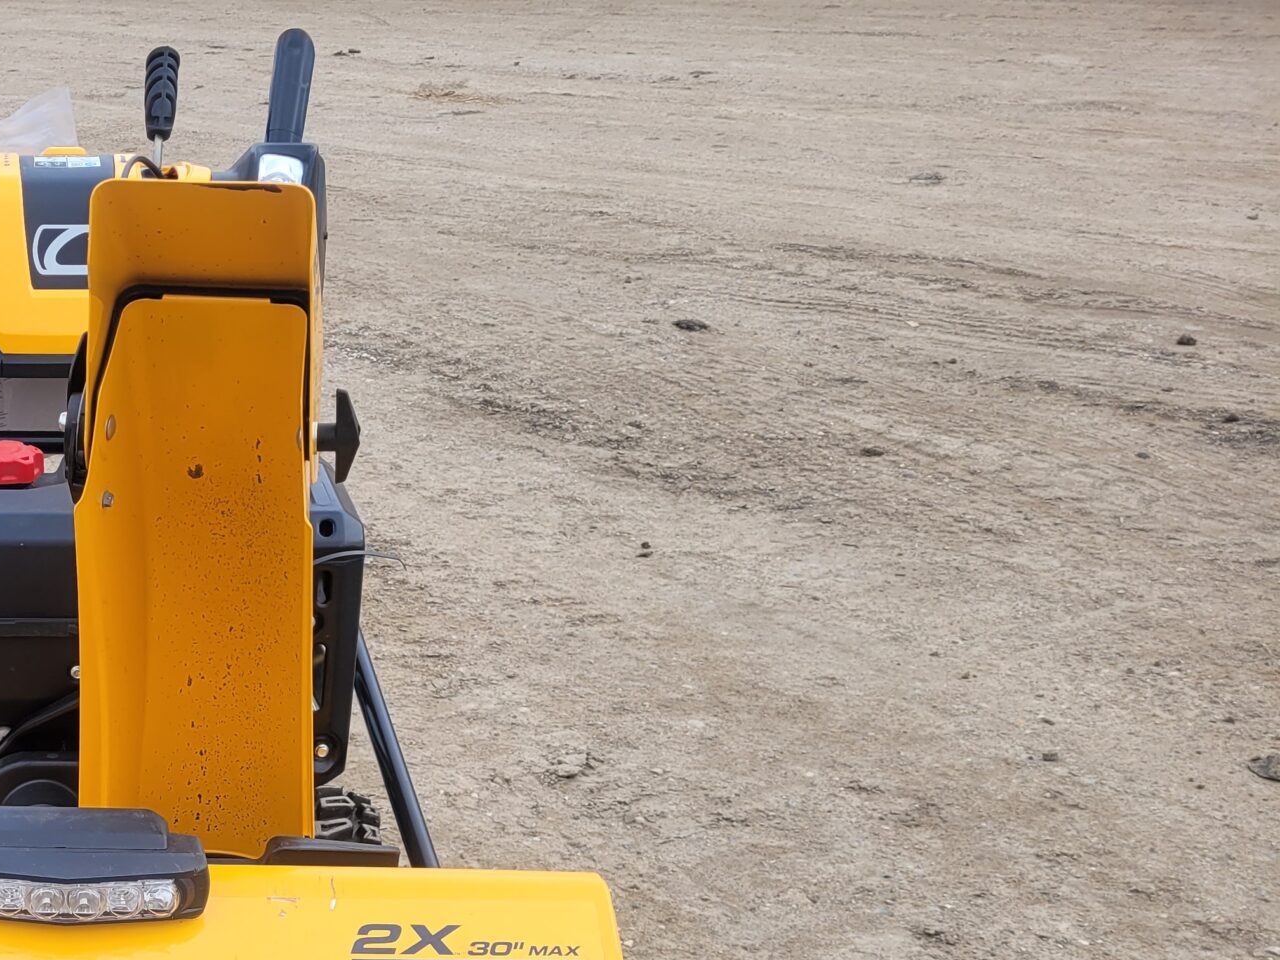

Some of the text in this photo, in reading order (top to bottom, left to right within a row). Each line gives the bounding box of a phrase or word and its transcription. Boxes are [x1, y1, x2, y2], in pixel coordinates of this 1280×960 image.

[350, 923, 581, 957] 2X 30" MAX
